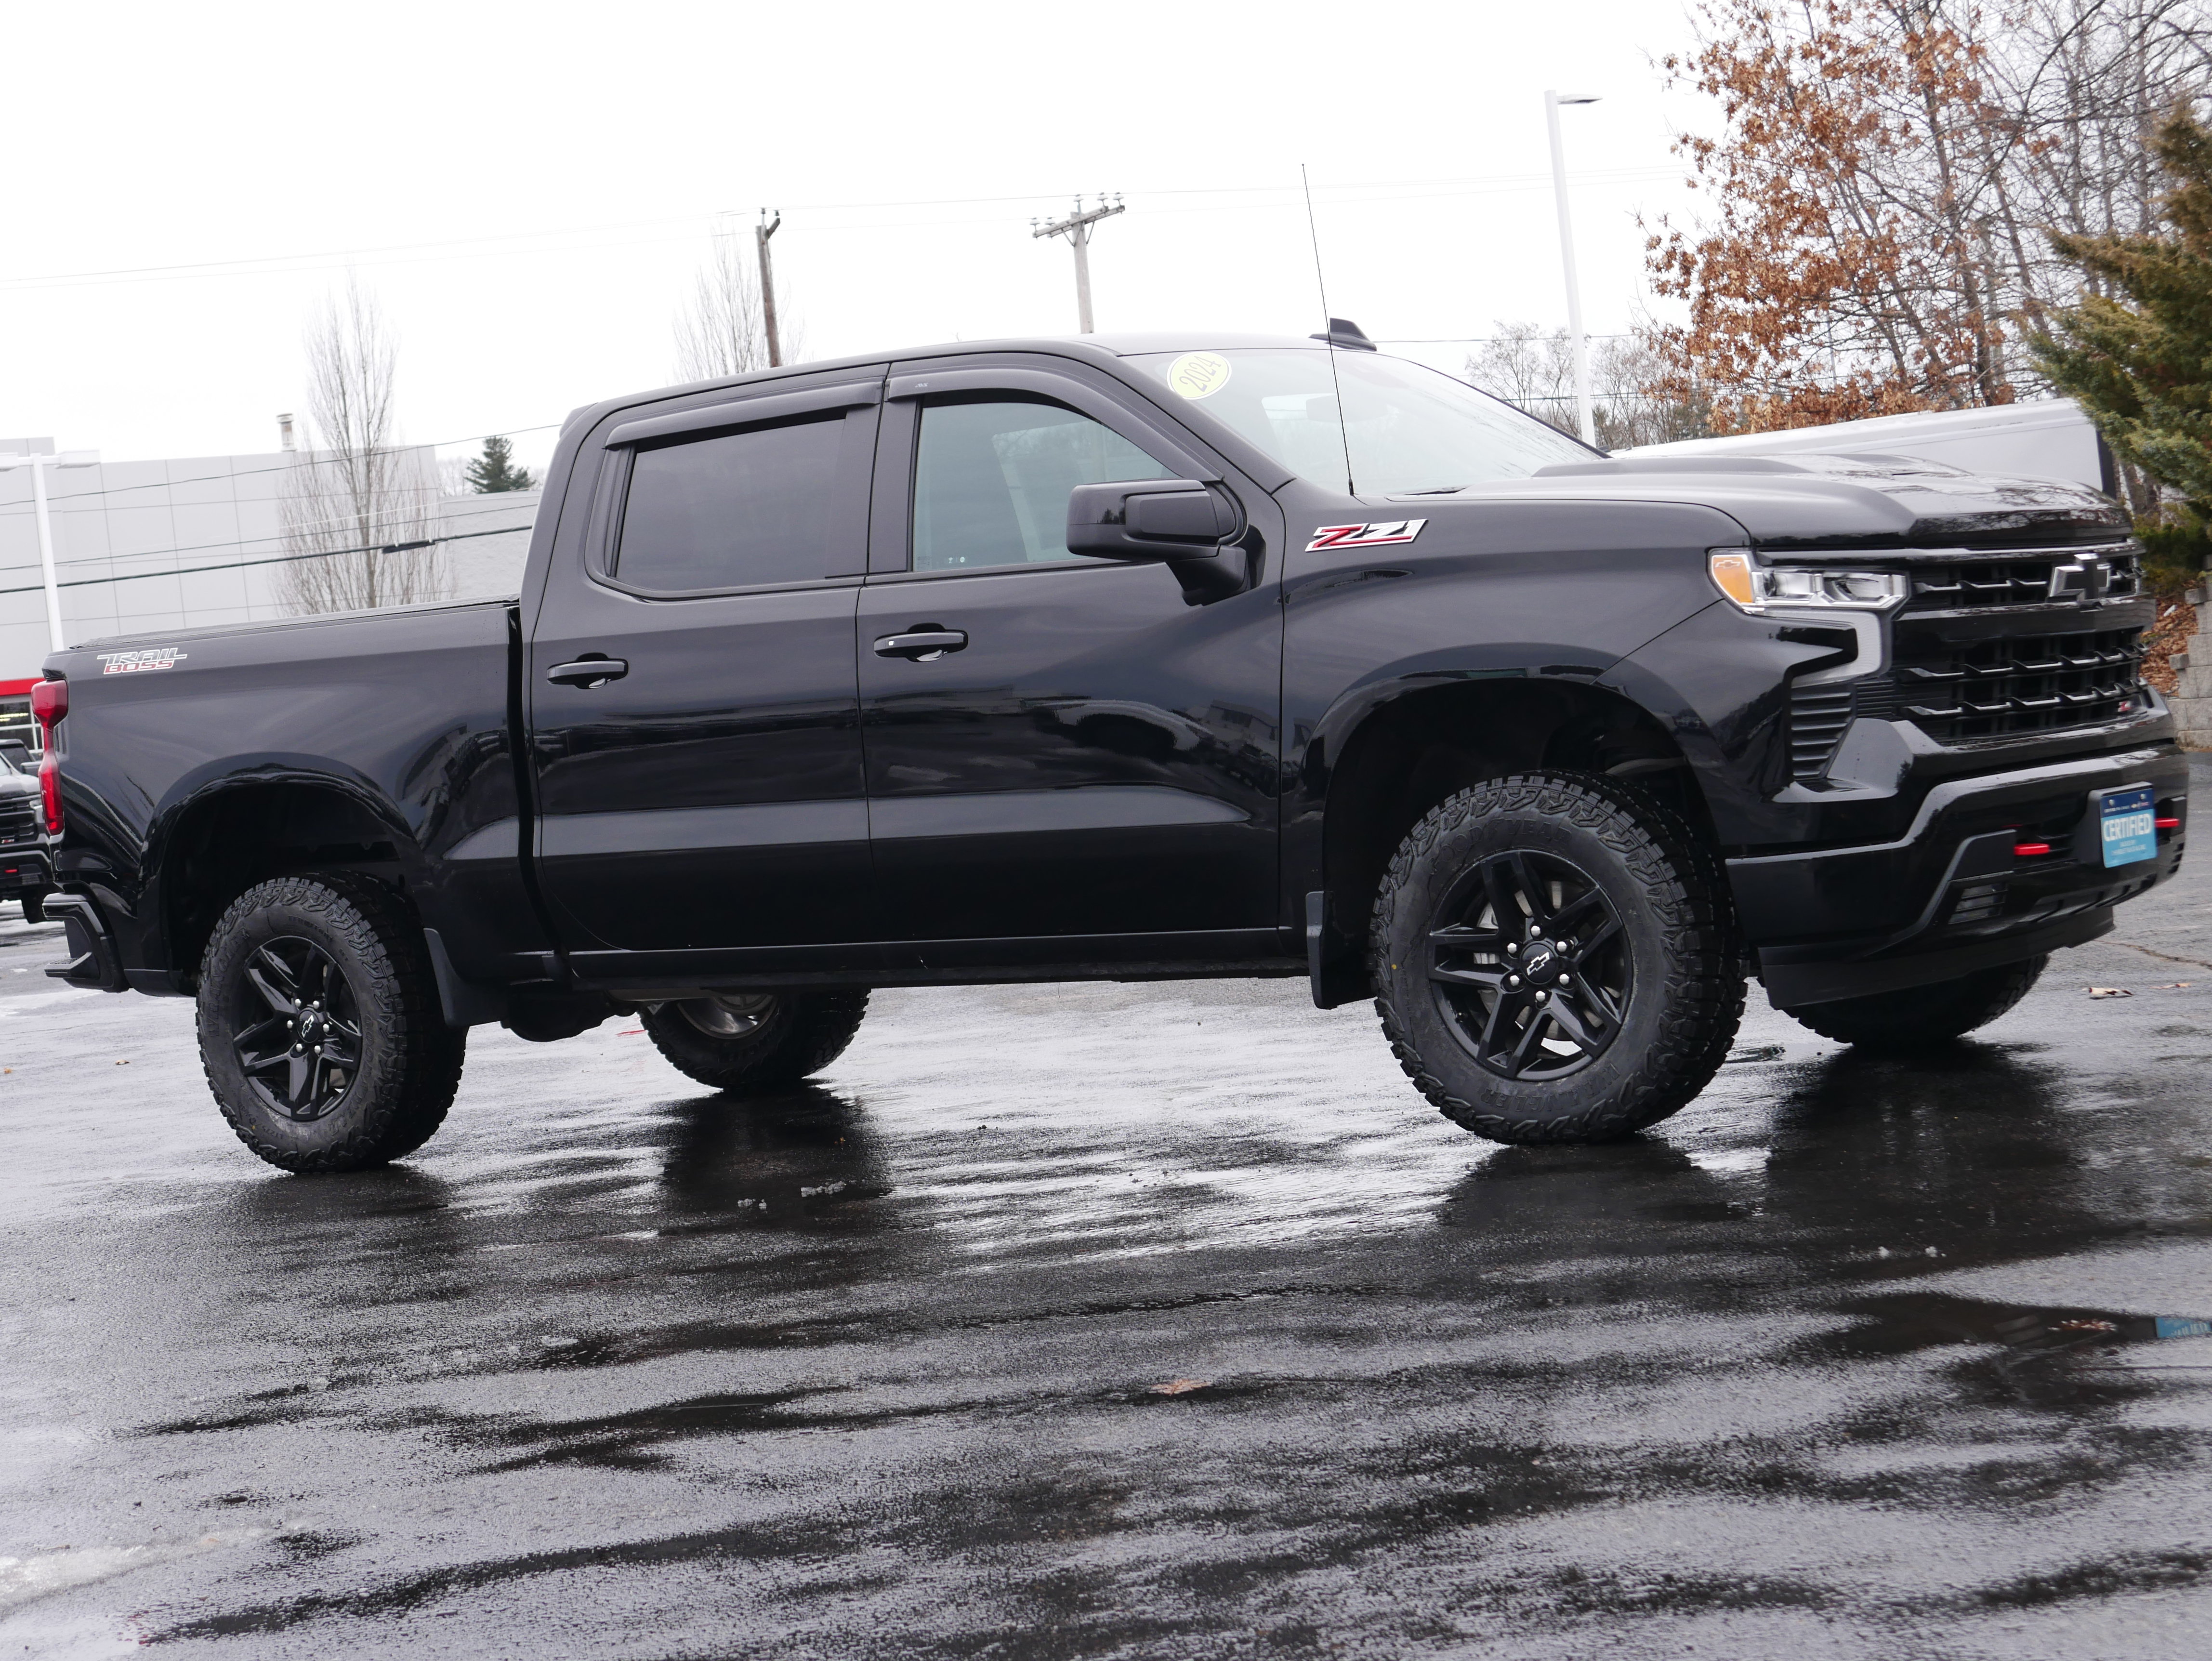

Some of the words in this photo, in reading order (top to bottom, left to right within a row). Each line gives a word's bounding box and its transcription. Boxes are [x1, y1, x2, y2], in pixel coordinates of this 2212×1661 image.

[1179, 356, 1222, 393] 2024
[1305, 518, 1429, 552] Z71
[97, 647, 187, 664] TRAIL
[103, 659, 175, 674] BOSS
[2104, 813, 2151, 842] CERTIFIED
